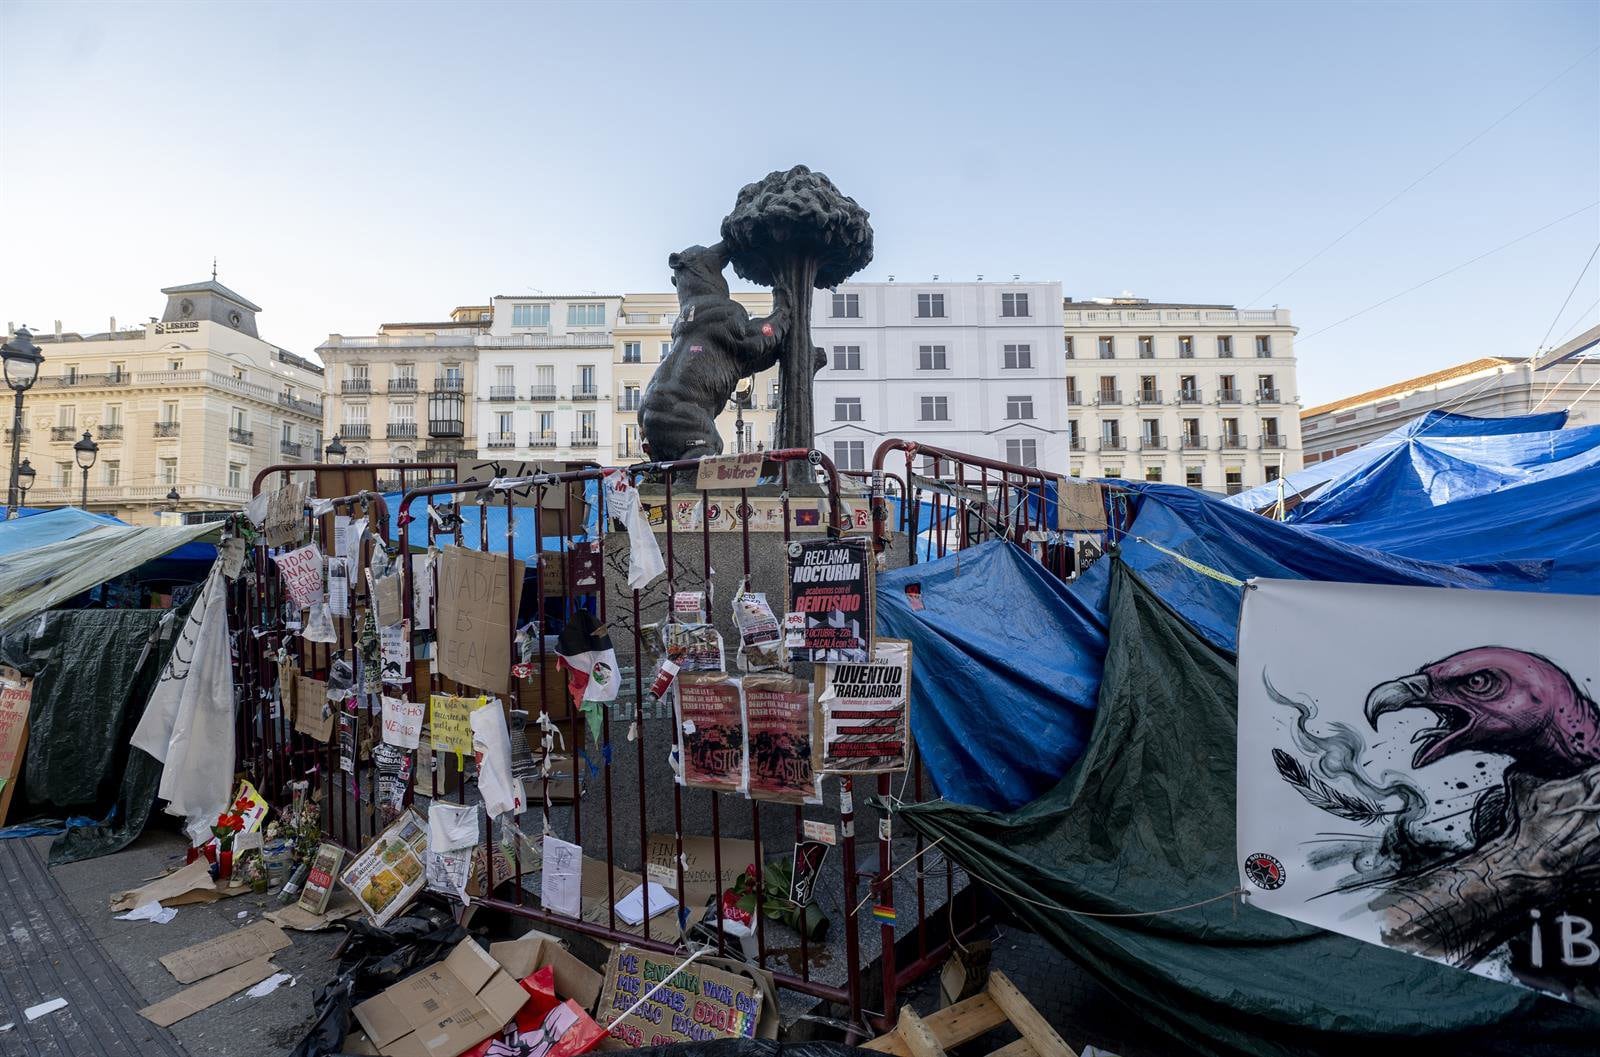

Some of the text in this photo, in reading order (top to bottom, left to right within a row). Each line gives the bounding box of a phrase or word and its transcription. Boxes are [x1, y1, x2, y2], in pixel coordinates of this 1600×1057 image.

[166, 321, 199, 330] LEGENDS
[803, 548, 850, 565] RECLAMA
[793, 563, 861, 582] NOCTURNA
[444, 564, 507, 606] NADIE
[795, 594, 861, 613] RENTISMO
[456, 608, 473, 632] ES
[809, 628, 836, 638] OCTUBRE
[832, 665, 903, 684] JUVENTUD
[833, 684, 902, 699] TRABAJADORA
[1246, 867, 1270, 890] OBRERA
[1250, 853, 1286, 886] SOLIDARIDAD
[618, 953, 640, 975] ME
[616, 974, 641, 996] MIS
[693, 1000, 728, 1032] ODIO
